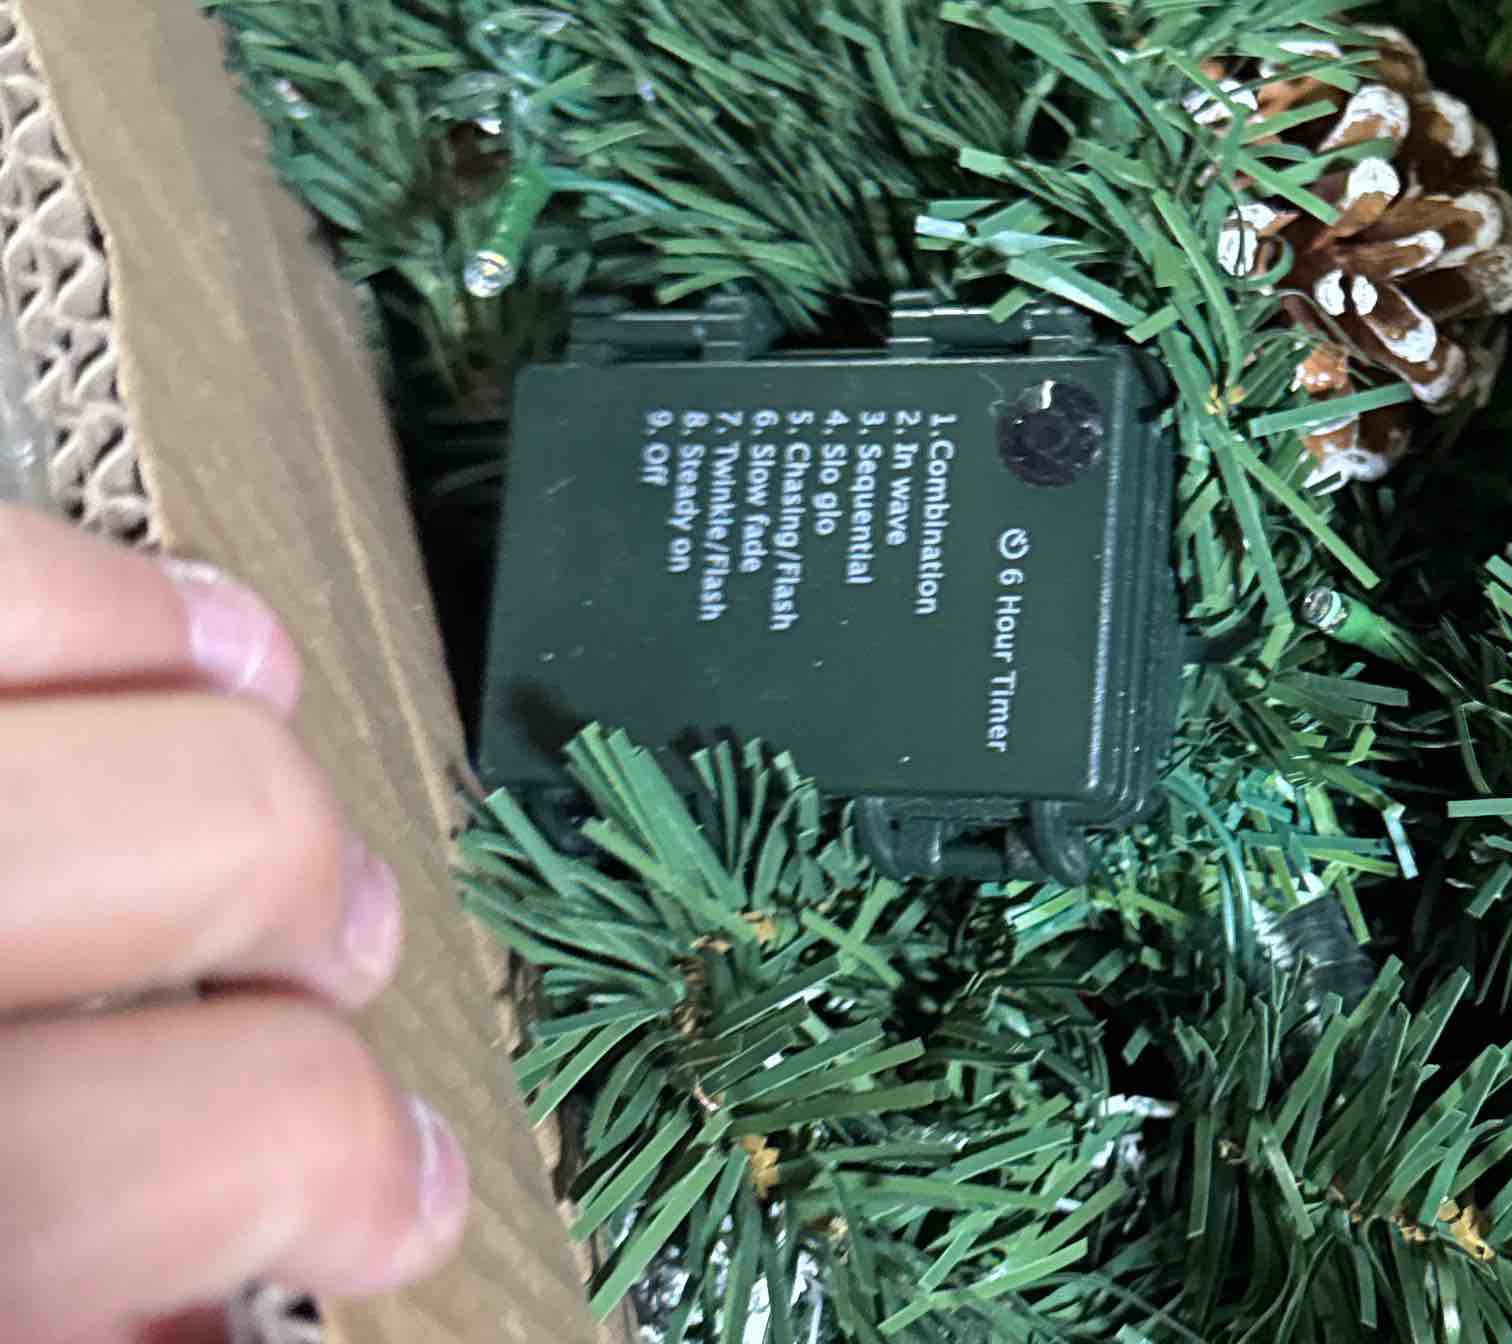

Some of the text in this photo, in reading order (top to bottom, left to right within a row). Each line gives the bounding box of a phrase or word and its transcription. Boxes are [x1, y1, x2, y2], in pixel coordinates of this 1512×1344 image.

[640, 410, 672, 487] 9. Off
[669, 411, 707, 572] 8. Steady on
[698, 410, 742, 621] 7. Twinkle/Flash
[740, 410, 778, 572] 6. Slow fade
[769, 410, 813, 631] 5. Chasing/Flash
[812, 410, 848, 536] 4. Slo glo
[846, 411, 885, 584] 3. Sequential
[886, 410, 920, 546] 2. In wave
[986, 569, 1022, 752] 6 Hour Timer
